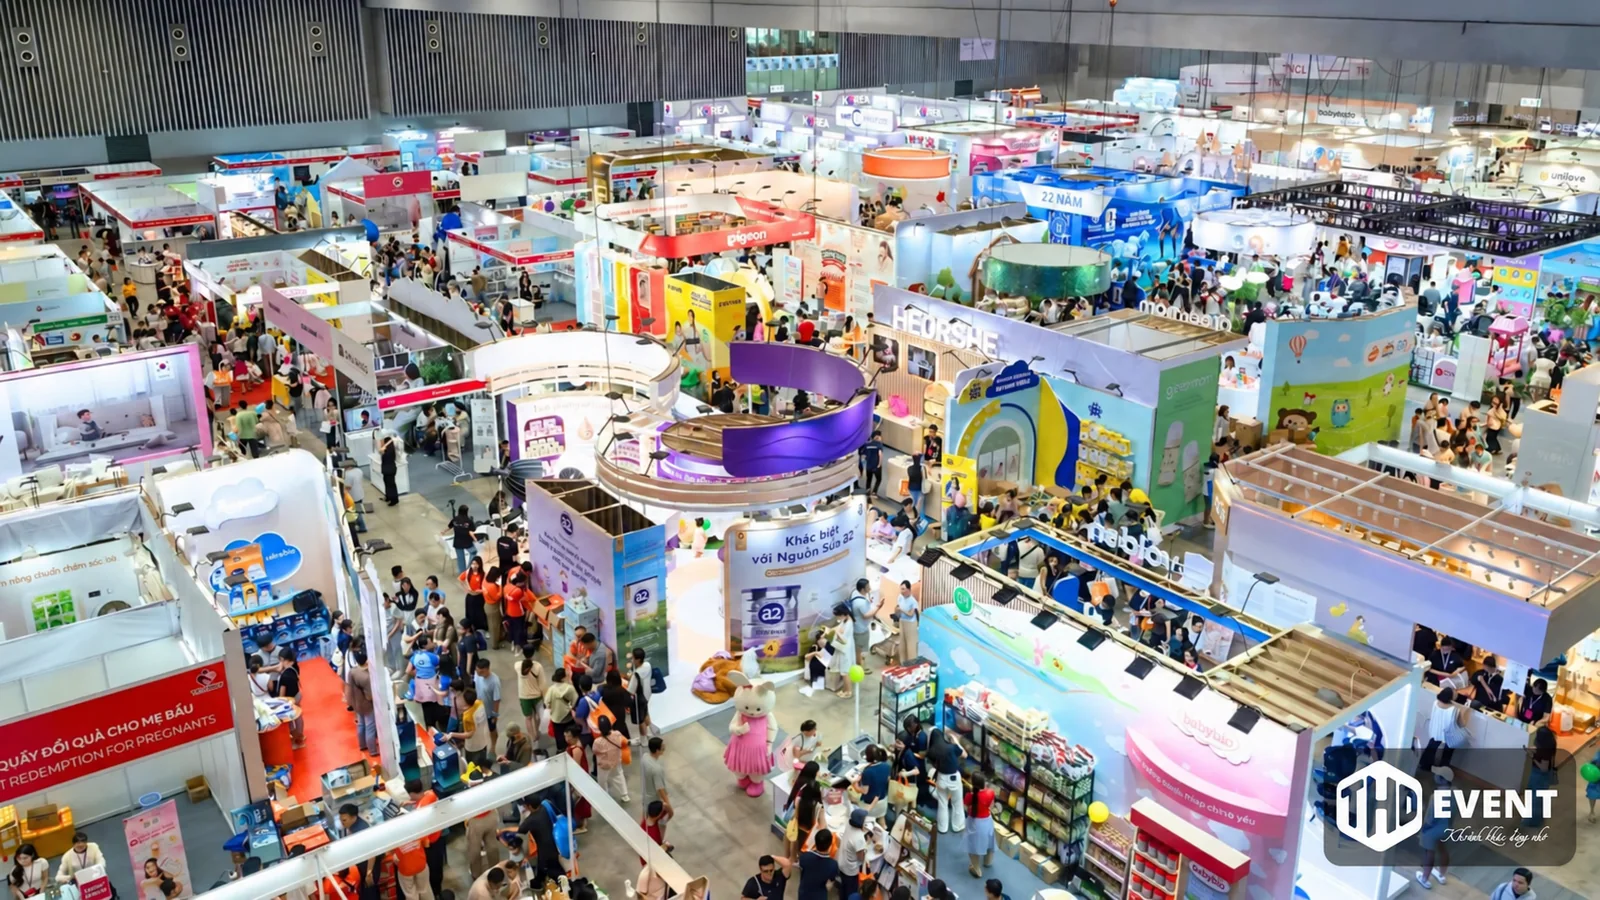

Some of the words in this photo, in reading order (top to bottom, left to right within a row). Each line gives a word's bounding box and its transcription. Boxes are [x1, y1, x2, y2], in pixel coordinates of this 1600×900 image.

[842, 95, 871, 105] KOREA
[696, 104, 730, 117] KOREA
[914, 105, 943, 118] KOREA
[802, 114, 830, 128] KOREA
[1551, 172, 1586, 182] unilove
[1042, 191, 1054, 203] 22
[727, 231, 767, 247] pigeon
[785, 533, 816, 547] Khác
[819, 525, 840, 540] biệt
[751, 553, 773, 565] với
[842, 530, 855, 545] a2
[635, 591, 650, 604] a2
[761, 607, 782, 621] a2
[71, 728, 106, 749] QUÀ
[107, 720, 139, 737] CHO
[141, 712, 164, 726] MẸ
[1183, 712, 1234, 748] babybio
[9, 748, 105, 788] REDEMPTION
[106, 739, 135, 757] FOR
[136, 714, 217, 748] PREGNANTS
